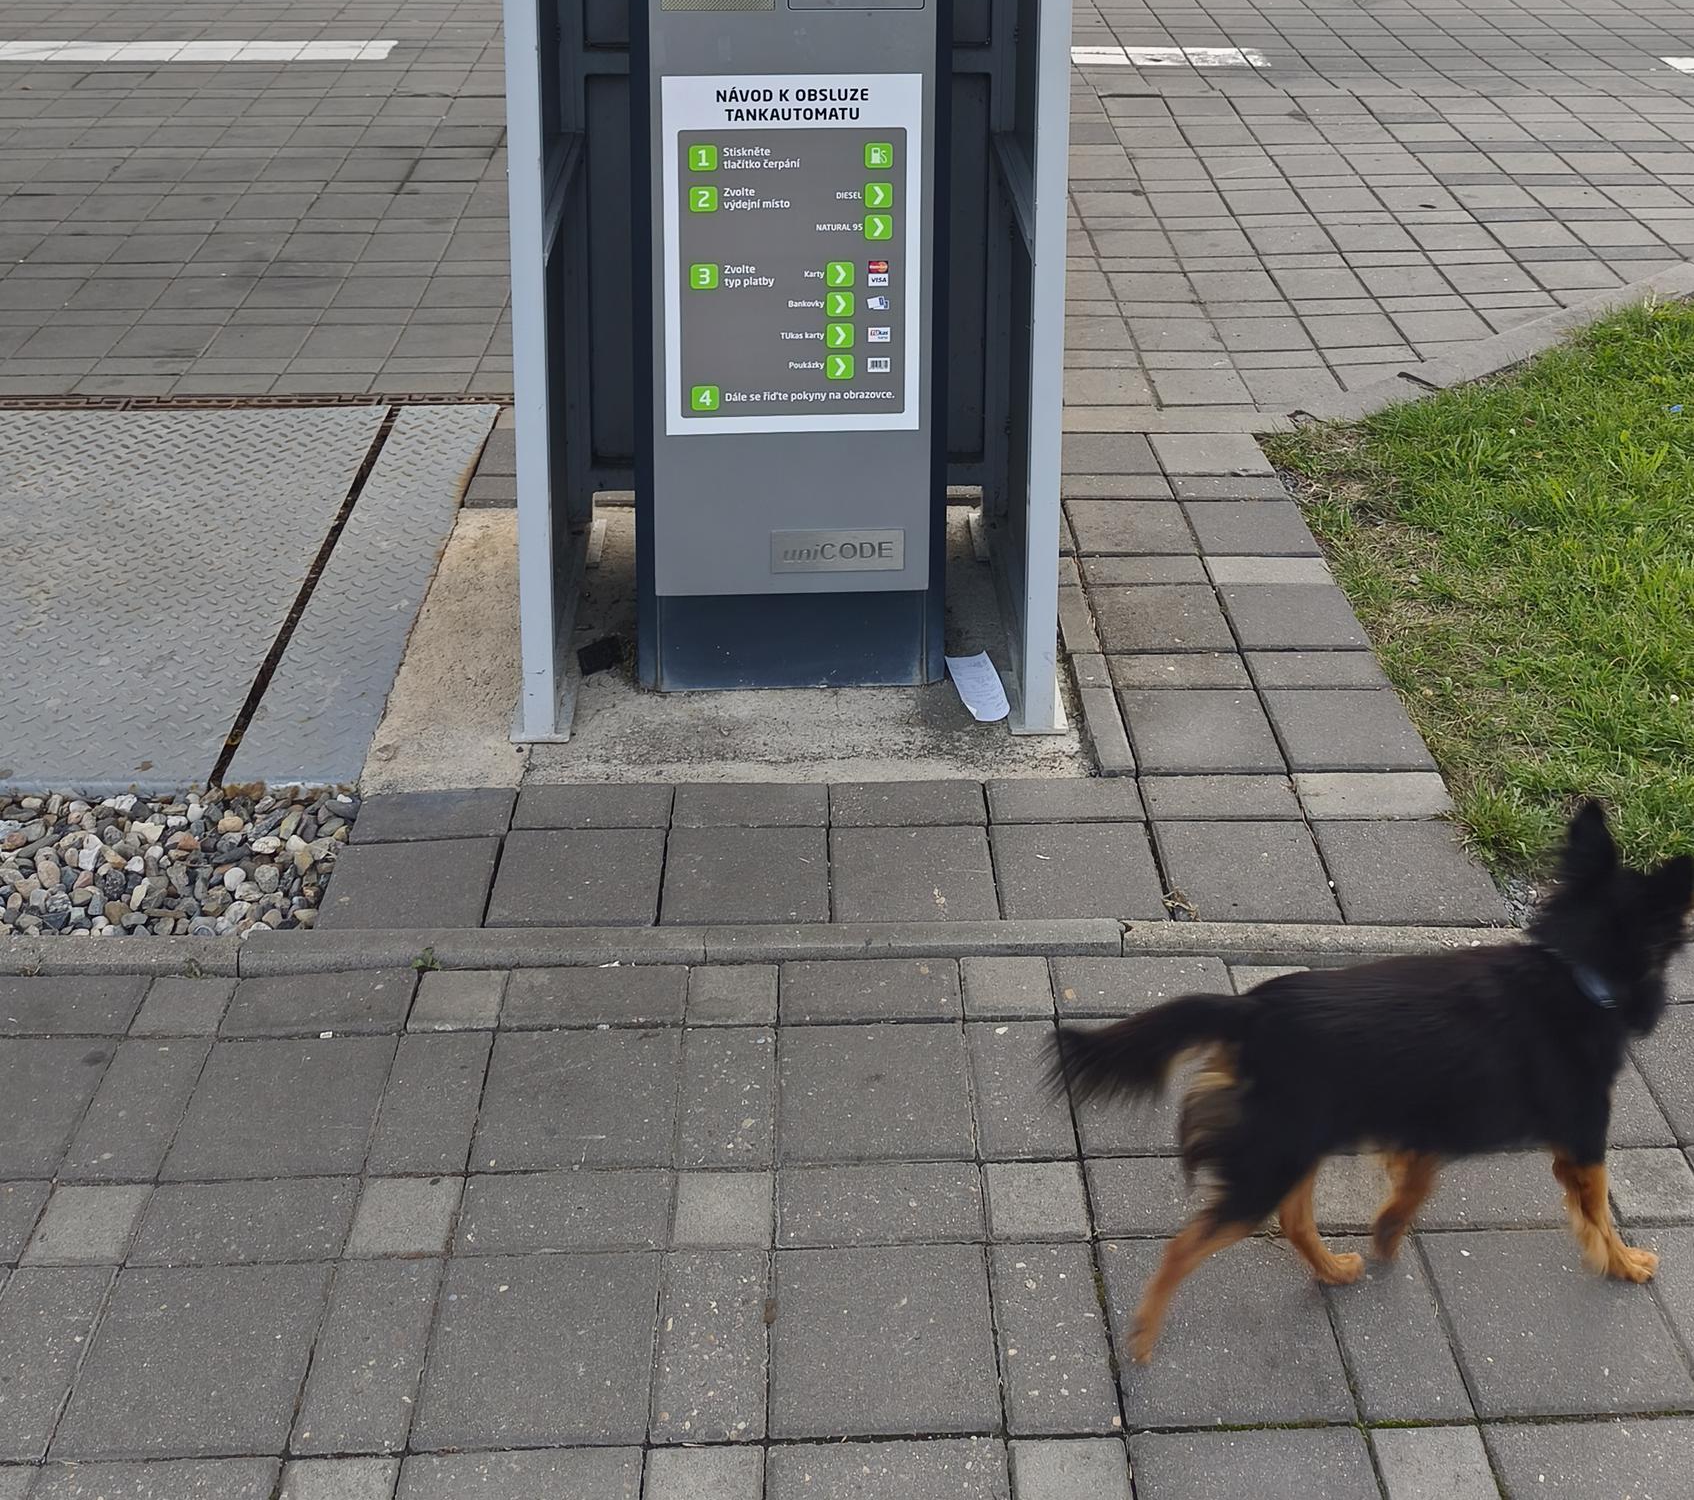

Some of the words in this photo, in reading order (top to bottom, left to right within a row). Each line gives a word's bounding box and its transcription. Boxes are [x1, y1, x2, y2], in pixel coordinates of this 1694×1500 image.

[716, 87, 773, 102] NÁVOD
[779, 89, 790, 102] K
[795, 88, 869, 101] OBSLUZE
[725, 107, 860, 121] TANKAUTOMATU
[723, 146, 771, 157] Stiskněte
[698, 149, 709, 167] 1
[723, 159, 761, 169] tlačítko
[763, 158, 800, 170] čerpání
[723, 187, 755, 197] Zvolte
[835, 191, 862, 200] DIESEL
[698, 190, 710, 208] 2
[723, 198, 760, 211] výdejní
[762, 198, 791, 208] místo
[815, 223, 851, 231] NATURAL
[852, 223, 863, 231] 95
[724, 265, 756, 274] Zvolte
[804, 270, 825, 279] Karty
[698, 268, 711, 285] 3
[724, 278, 741, 288] typ
[743, 276, 775, 288] platby
[787, 300, 825, 309] Bankovky
[780, 332, 803, 340] TUkas
[804, 332, 825, 340] karty
[788, 361, 825, 370] Poukázky
[699, 389, 712, 406] 4
[725, 392, 747, 402] Dále
[749, 393, 761, 401] se
[790, 391, 827, 403] pokyny
[828, 392, 841, 400] na
[843, 390, 895, 400] obrazovce.
[783, 541, 894, 562] uniCODE
